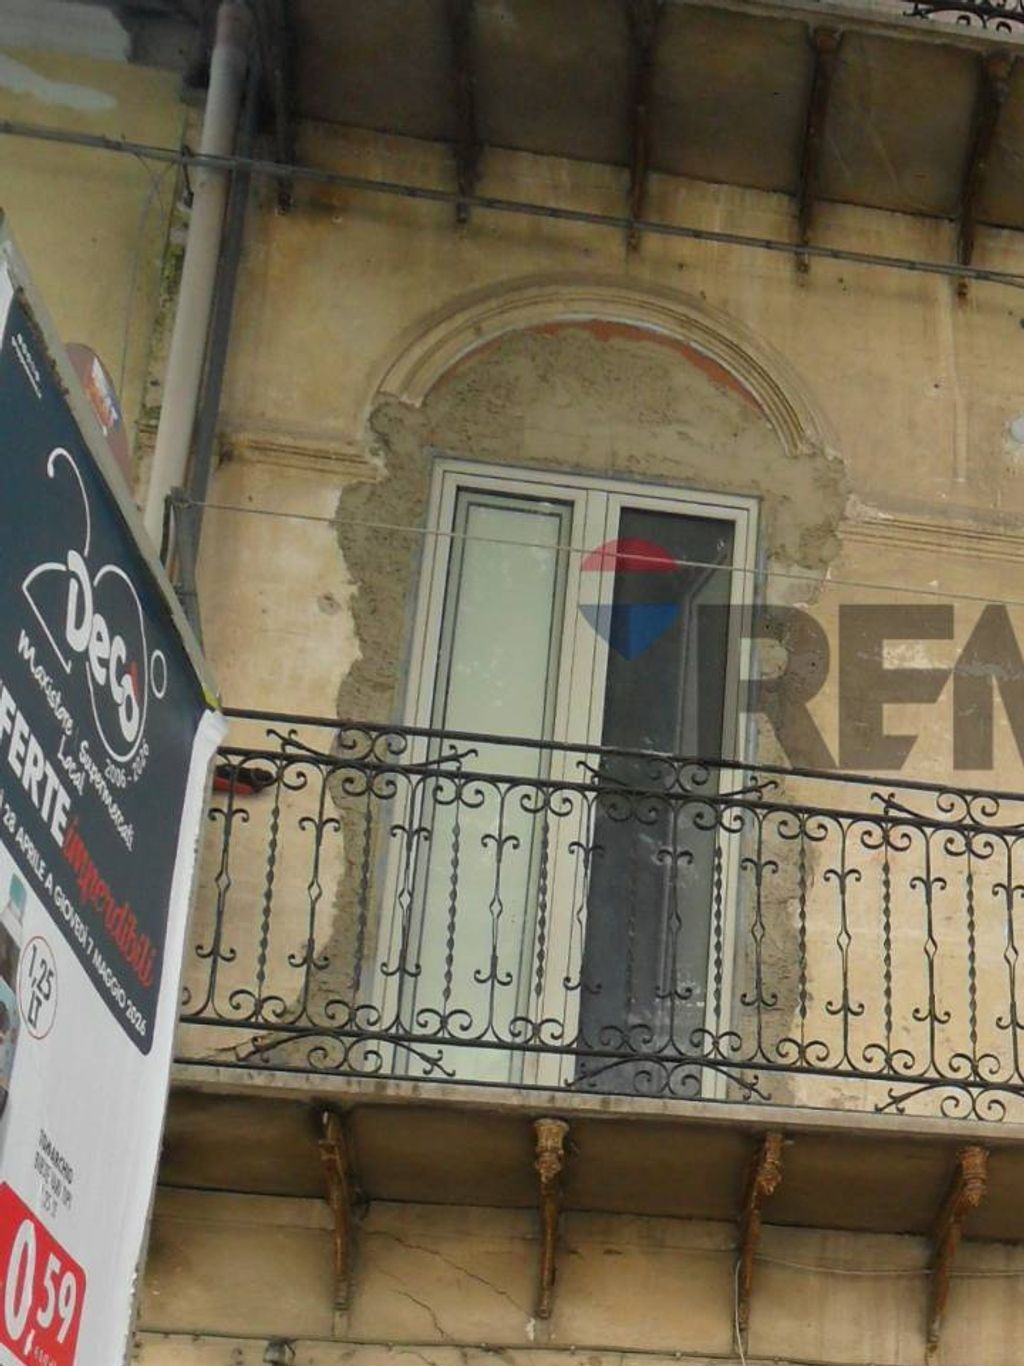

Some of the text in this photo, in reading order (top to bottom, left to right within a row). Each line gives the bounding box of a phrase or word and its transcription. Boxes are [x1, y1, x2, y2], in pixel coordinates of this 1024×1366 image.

[15, 827, 46, 881] APRILE
[44, 872, 53, 896] A
[86, 937, 94, 955] 7
[92, 949, 127, 1009] MAGGIO
[125, 1000, 147, 1036] 2026
